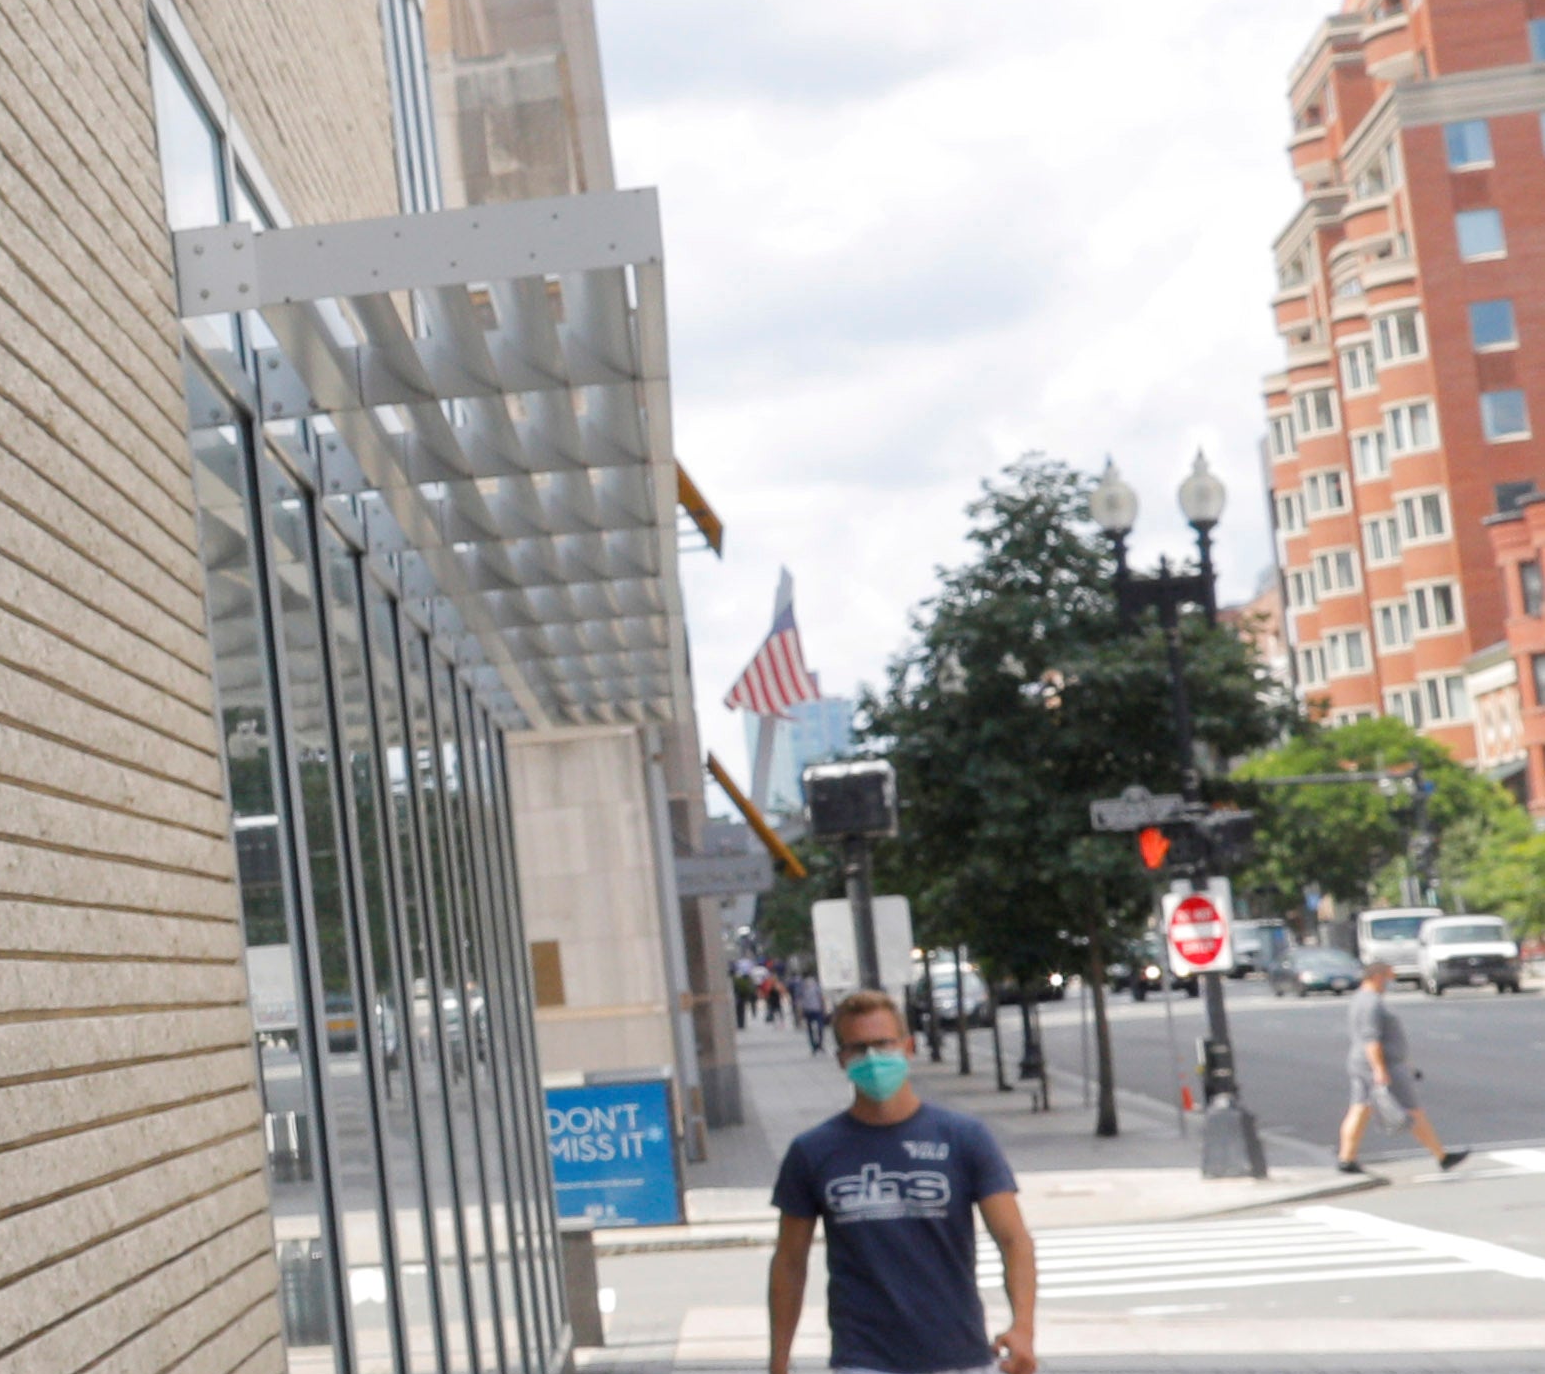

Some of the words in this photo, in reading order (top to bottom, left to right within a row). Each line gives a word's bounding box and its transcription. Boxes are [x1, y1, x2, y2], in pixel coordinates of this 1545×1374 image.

[545, 1103, 640, 1135] DON'T
[548, 1133, 616, 1163] MISS
[621, 1131, 645, 1159] IT
